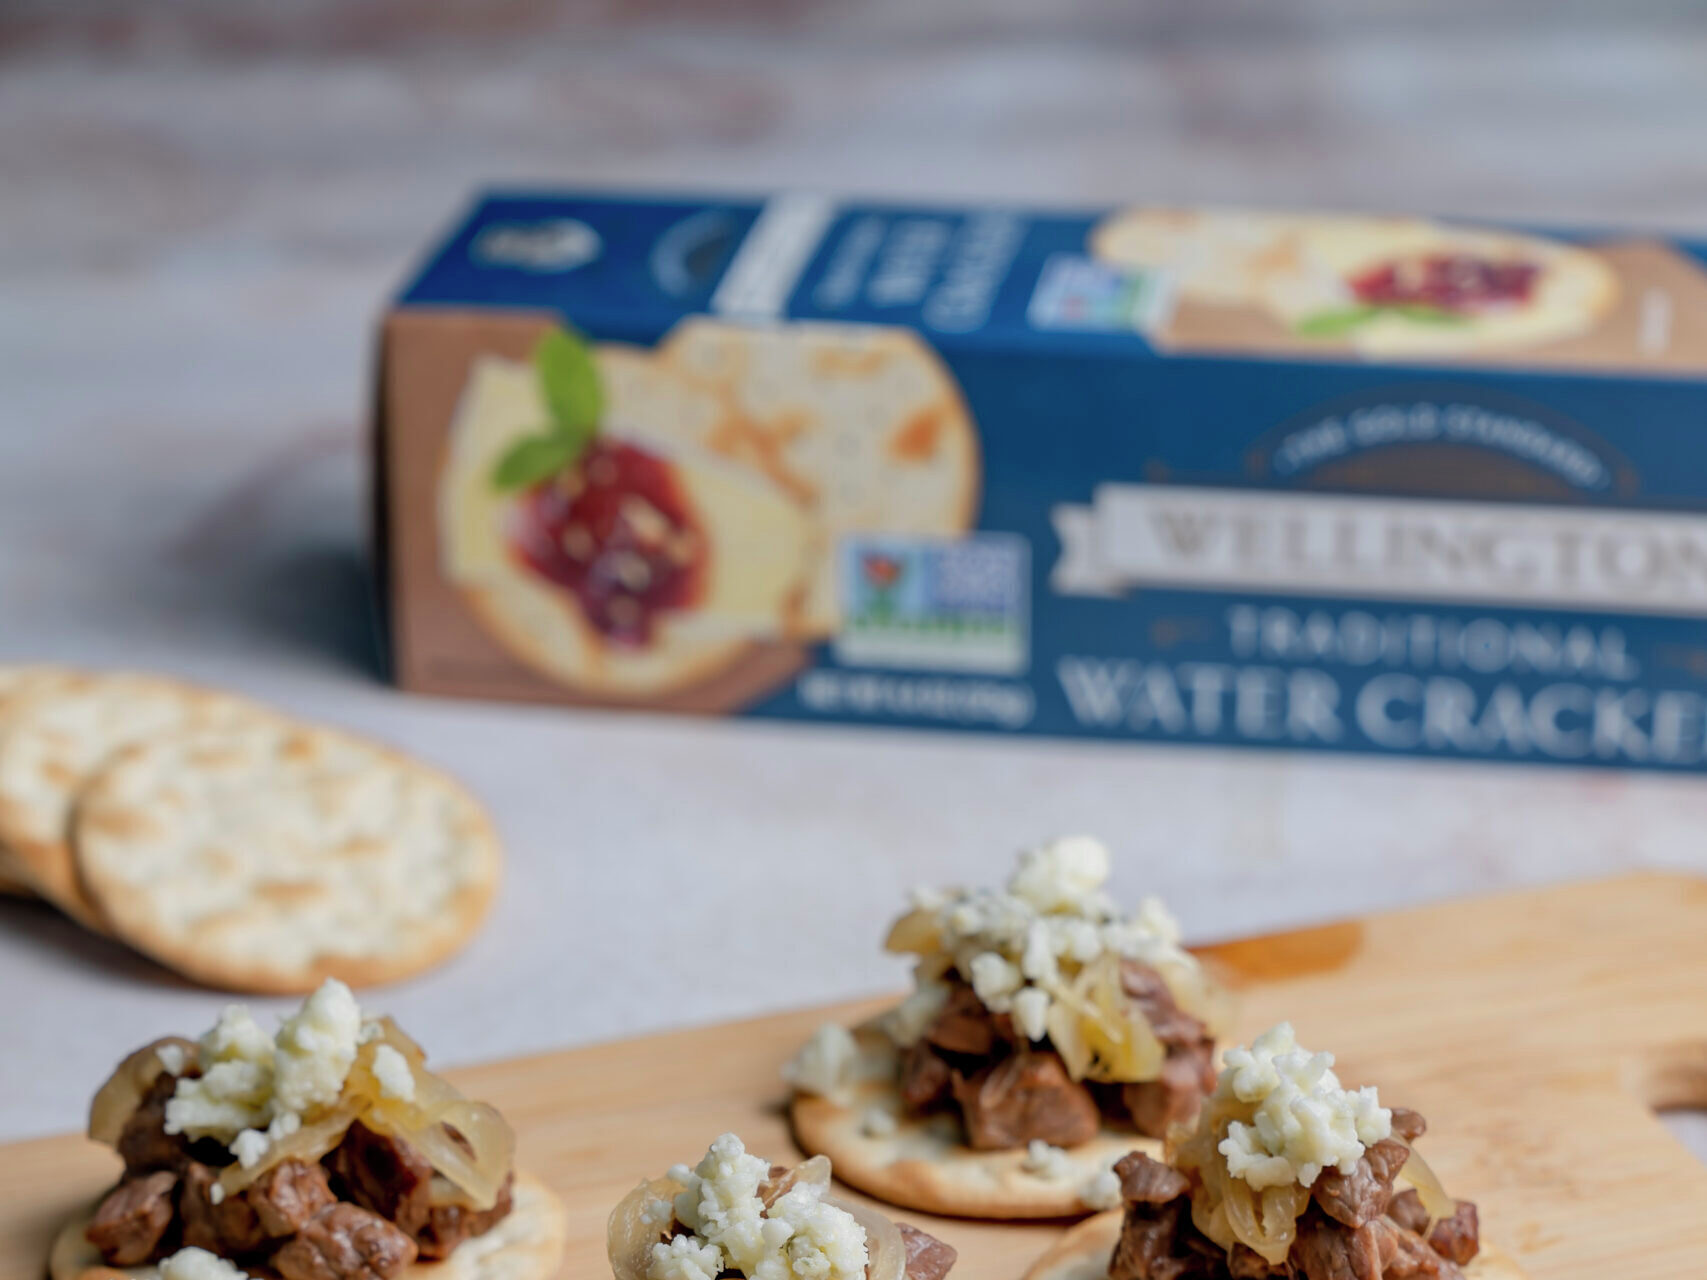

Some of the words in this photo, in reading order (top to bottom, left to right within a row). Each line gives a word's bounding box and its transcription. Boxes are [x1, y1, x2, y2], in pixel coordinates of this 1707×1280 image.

[1227, 604, 1640, 680] TRADITIONAL
[1057, 655, 1344, 741] WATER
[1356, 673, 1707, 763] CRACKE
